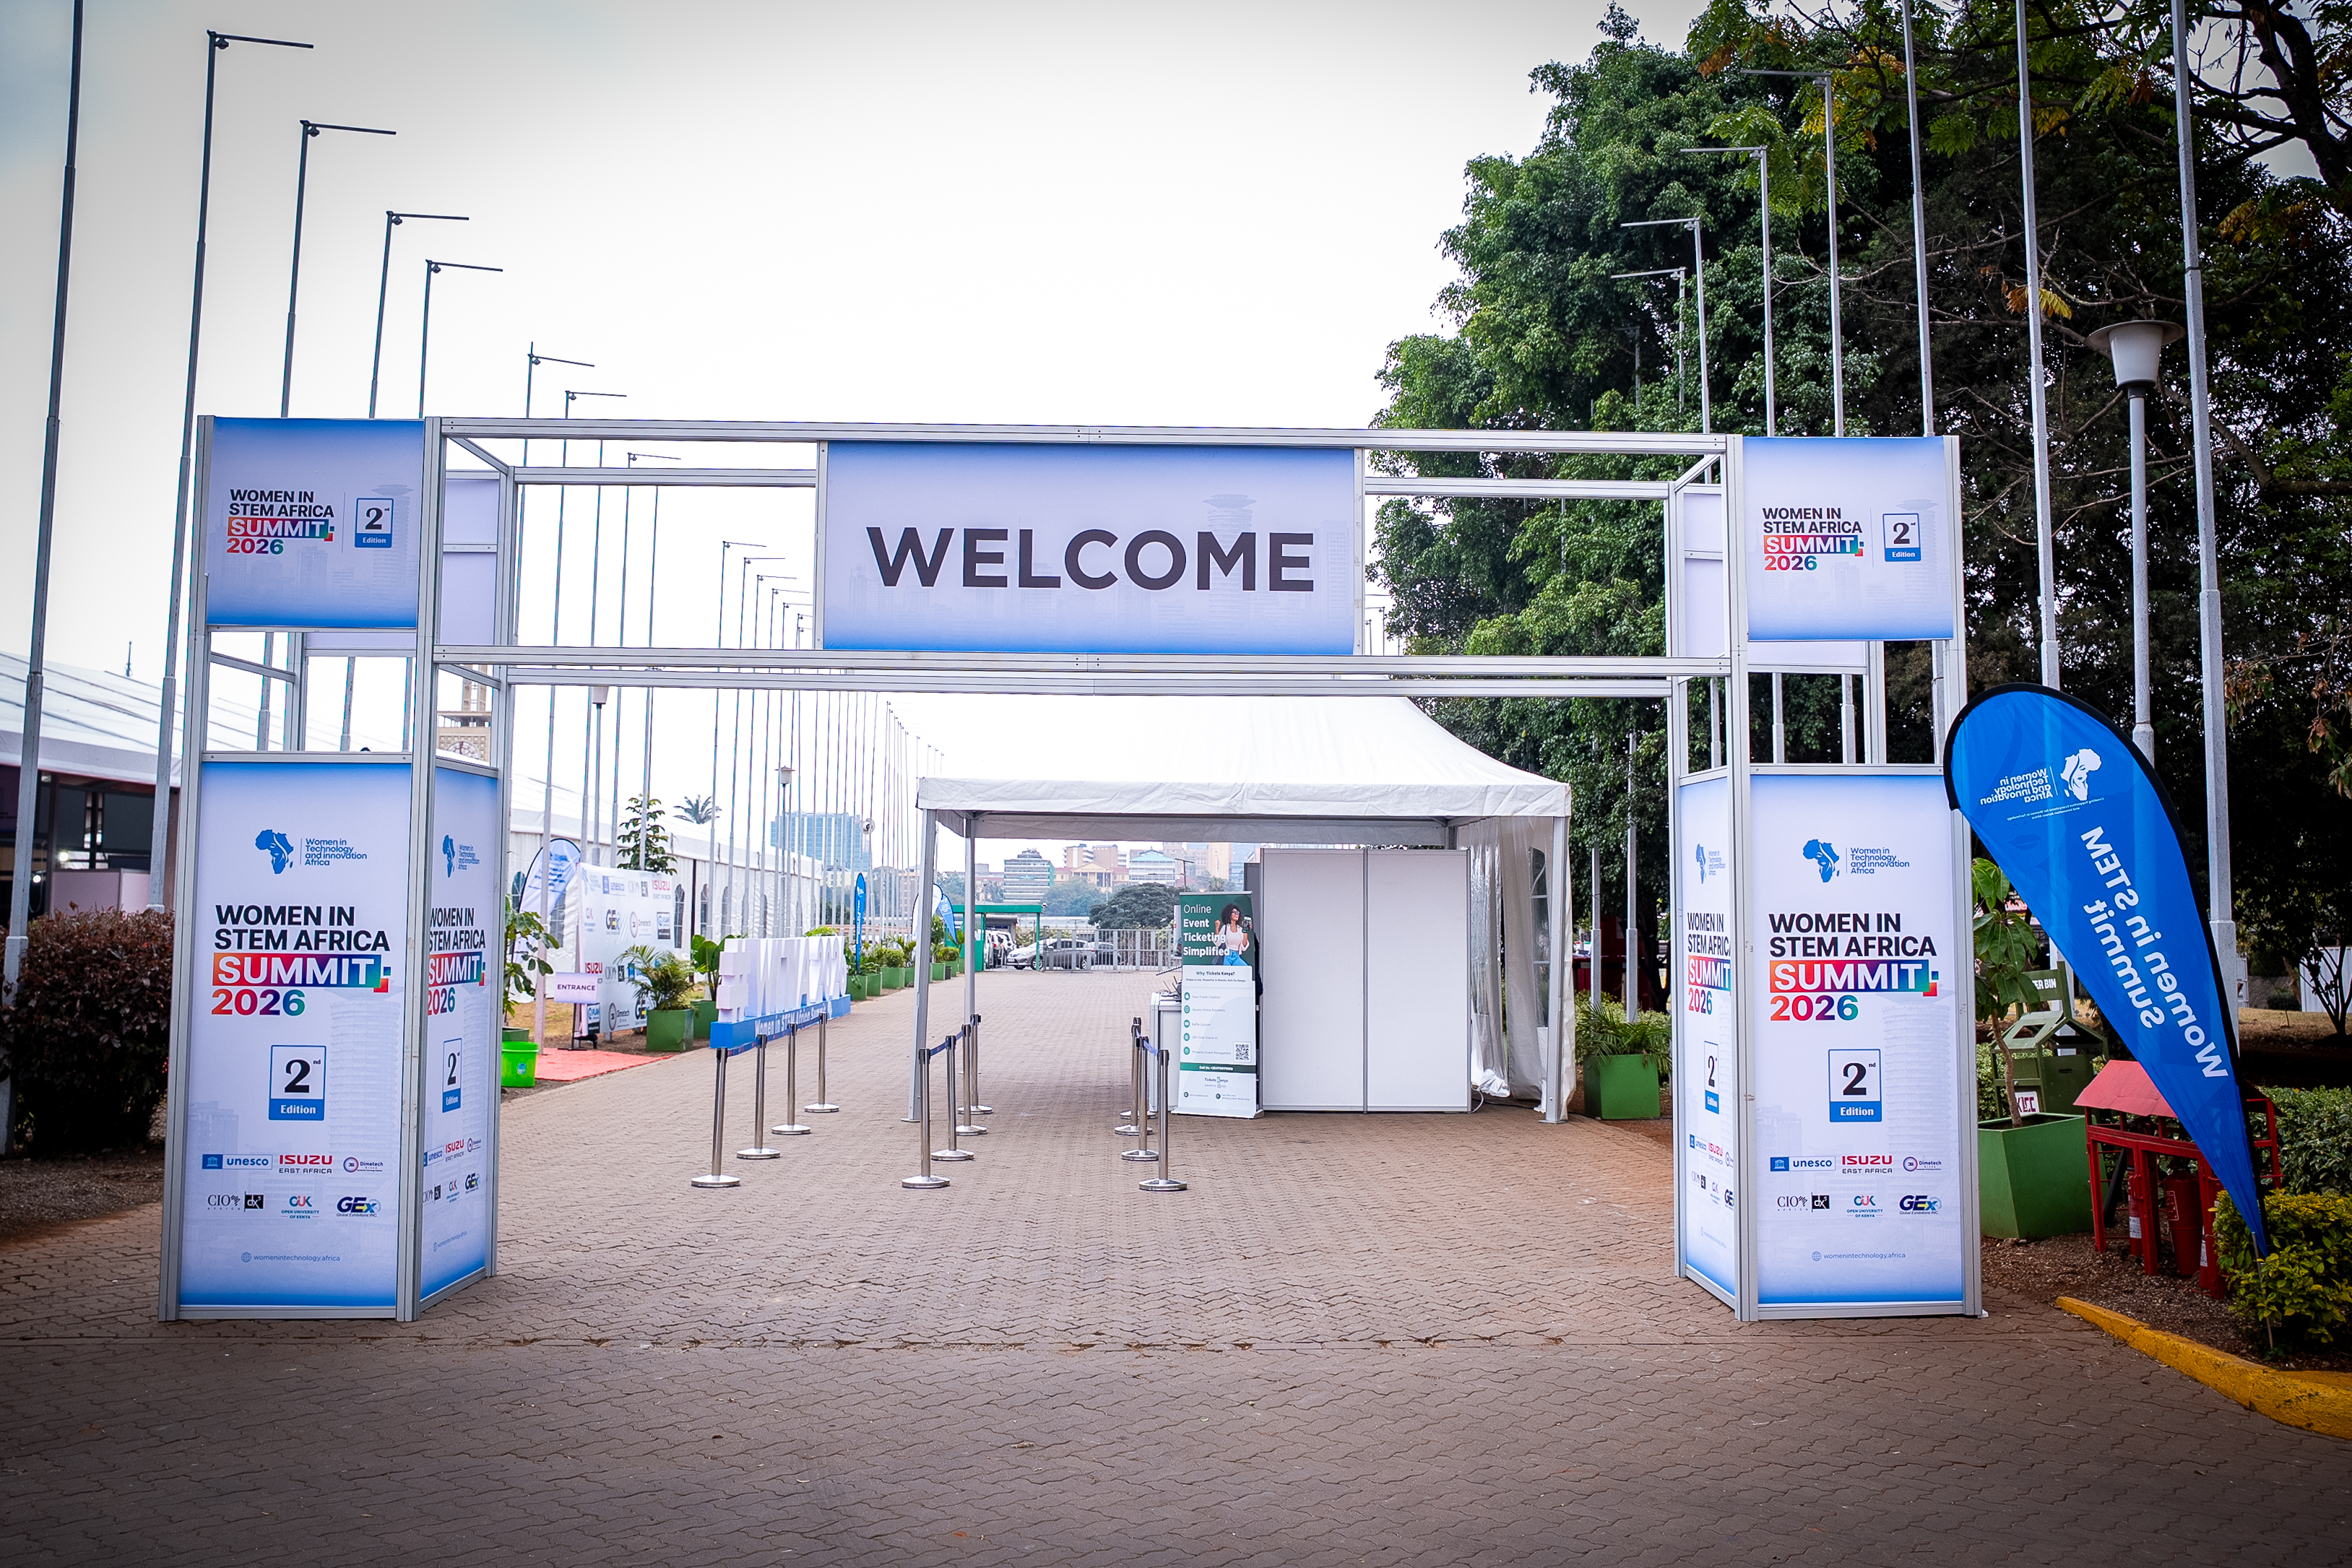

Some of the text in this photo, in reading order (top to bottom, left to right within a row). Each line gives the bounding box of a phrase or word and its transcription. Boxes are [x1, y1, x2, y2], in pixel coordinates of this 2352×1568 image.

[230, 489, 314, 503] WOMEN IN
[229, 503, 334, 518] STEM AFRICA
[1763, 508, 1841, 519] WOMEN IN
[230, 519, 325, 537] SUMMIT
[1763, 521, 1862, 534] STEM AFRICA
[226, 538, 284, 555] 2026
[1766, 537, 1854, 553] SUMMIT
[866, 527, 1313, 592] WELCOME
[1765, 555, 1817, 571] 2026
[306, 845, 354, 854] Technology
[652, 880, 670, 891] ISUZU
[215, 905, 355, 926] WOMEN IN
[1183, 904, 1211, 914] Online
[431, 908, 474, 927] WOMEN IN
[1183, 918, 1209, 928] Event
[1687, 912, 1724, 932] WOMEN IN
[1768, 913, 1901, 933] WOMEN IN
[215, 929, 390, 951] STEM AFRICA
[429, 930, 485, 952] STEM AFRICA
[1183, 932, 1226, 943] Ticketing
[1687, 933, 1731, 956] STEM AFRIC
[1183, 946, 1230, 958] Simplified
[1770, 936, 1937, 957] STEM AFRICA
[218, 956, 374, 985] SUMMIT
[429, 956, 480, 984] SUMMIT
[585, 962, 602, 974] ISUZU
[1689, 958, 1731, 989] SUMMIT
[1774, 963, 1922, 990] SUMMIT
[2044, 978, 2057, 989] BIN
[212, 988, 306, 1016] 2026
[1689, 987, 1712, 1015] 2026
[1771, 995, 1859, 1021] 2026
[280, 1105, 316, 1114] Edition
[1840, 1107, 1874, 1117] Edition
[446, 1139, 464, 1153] ISUZU
[1708, 1142, 1723, 1156] ISUZU
[279, 1155, 332, 1165] ISUZU
[1842, 1156, 1893, 1165] ISUZU
[207, 1195, 230, 1206] CIO
[1777, 1195, 1799, 1208] CIO
[1823, 1252, 1906, 1260] womenintechnology.africa
